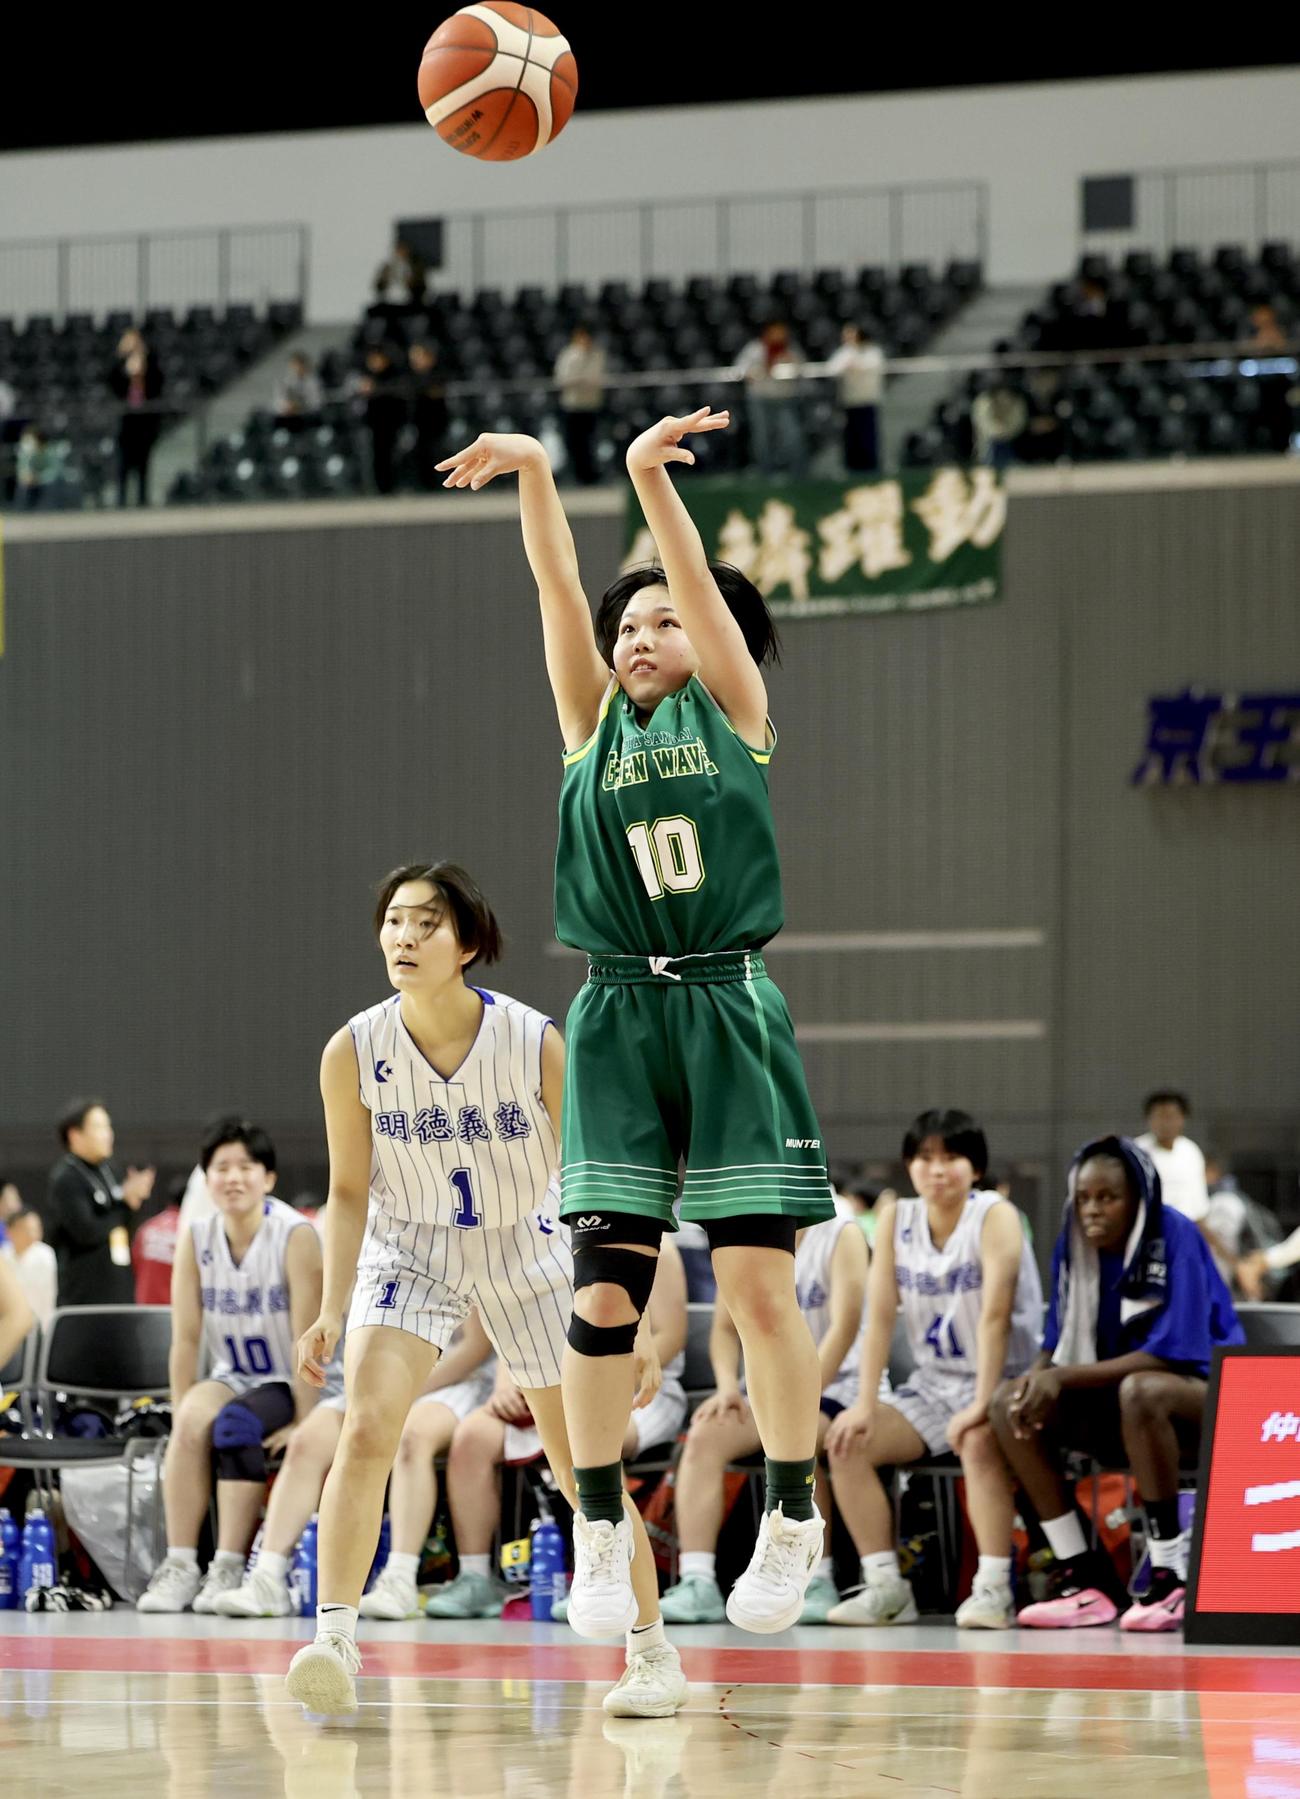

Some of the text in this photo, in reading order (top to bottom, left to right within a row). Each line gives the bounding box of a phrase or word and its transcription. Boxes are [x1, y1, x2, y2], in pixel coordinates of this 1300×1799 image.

[625, 814, 706, 901] 10
[375, 1101, 532, 1144] 明徳義塾
[448, 1166, 483, 1231] 1
[375, 1281, 401, 1309] 1
[223, 1334, 274, 1376] 10
[1259, 1410, 1300, 1443] 仲
